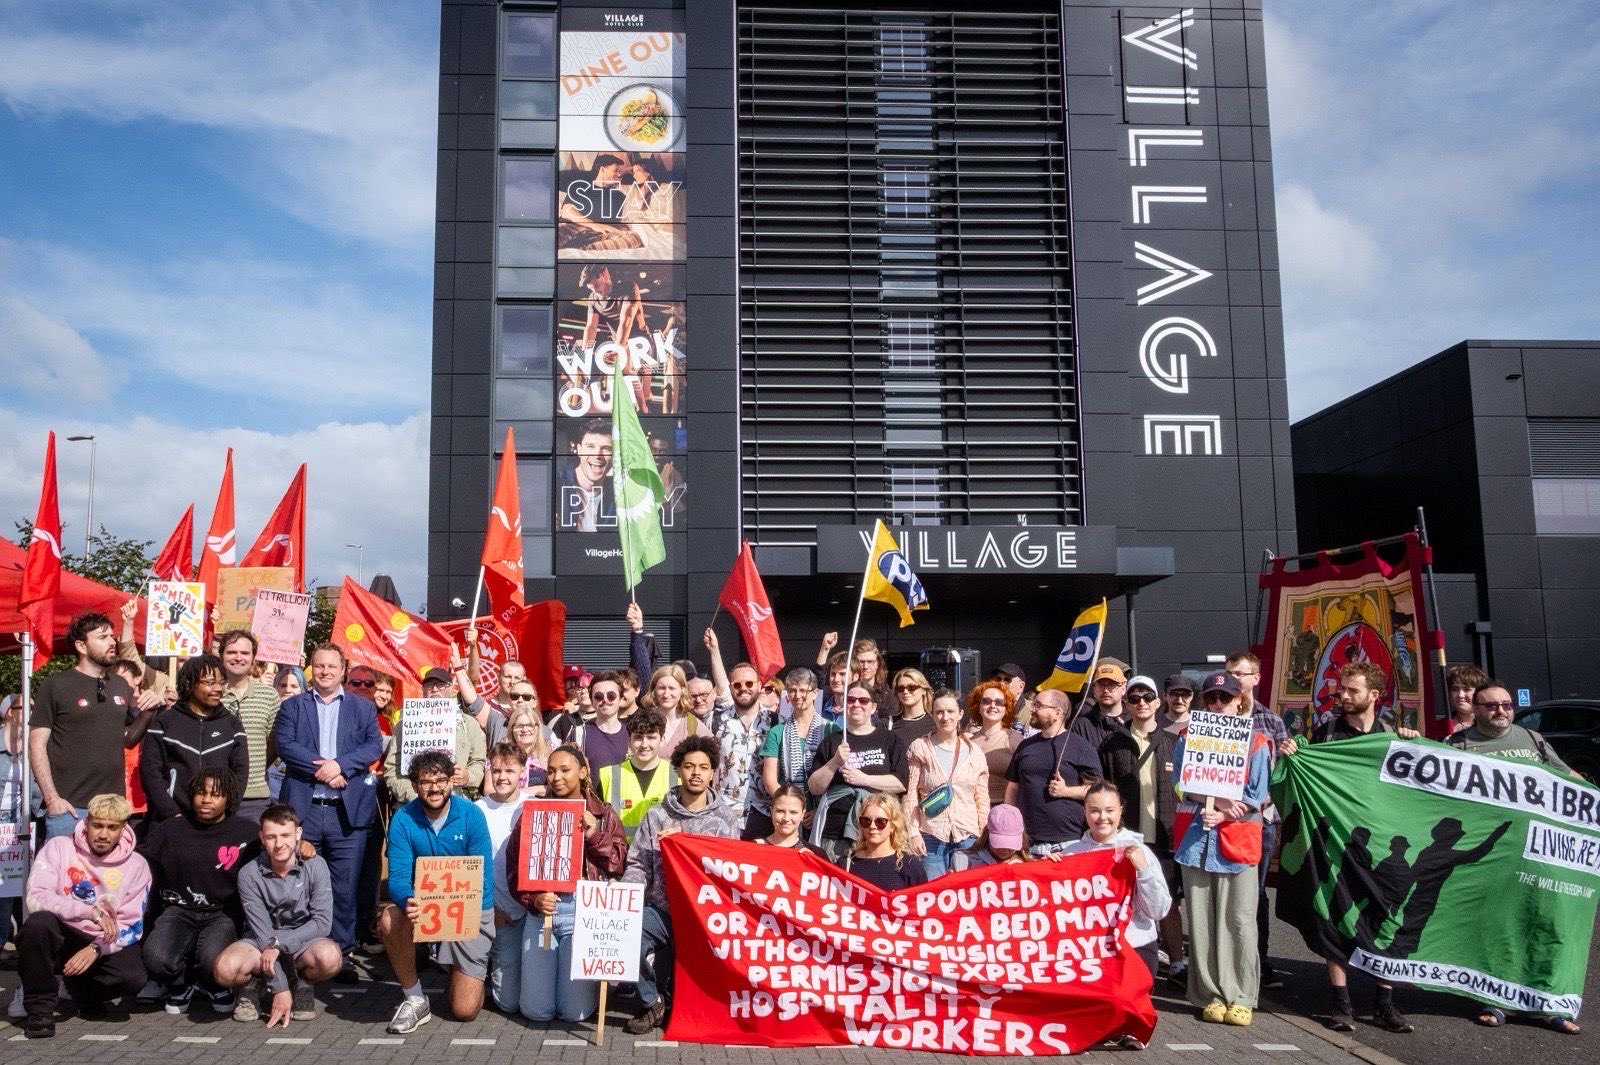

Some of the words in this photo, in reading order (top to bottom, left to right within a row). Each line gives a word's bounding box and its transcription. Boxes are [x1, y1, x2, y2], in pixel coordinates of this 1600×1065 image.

[605, 14, 644, 22] VILLAGE
[560, 51, 628, 96] DINE
[567, 180, 683, 219] STAY
[1122, 8, 1222, 455] VILLAGE
[557, 328, 686, 384] WORK
[561, 485, 687, 526] PLY
[236, 596, 257, 611] PA
[272, 591, 310, 606] TRILLION
[153, 602, 198, 654] SERVED
[504, 636, 516, 660] WORL
[405, 700, 450, 709] EDINBURGH
[404, 720, 443, 728] GLASGOW
[1188, 723, 1222, 738] STEALS
[1223, 728, 1250, 742] FROM
[1191, 711, 1252, 730] BLACKSTONE
[403, 739, 449, 748] ABERDEEN
[1187, 738, 1248, 755] WORKERS
[861, 759, 884, 767] VOICE
[1187, 750, 1204, 763] TO
[1209, 753, 1245, 767] FUND
[1182, 763, 1243, 785] GENOCIDE
[1386, 751, 1518, 803] GOVAN
[1524, 776, 1545, 808] &
[1529, 826, 1576, 863] LIVING
[1577, 839, 1600, 869] RE
[423, 860, 461, 870] VILLAGE
[582, 885, 640, 912] UNITE
[701, 856, 758, 885] NOT
[765, 870, 790, 892] A
[800, 871, 873, 904] PINT
[881, 894, 909, 917] IS
[1051, 874, 1115, 904] NOR
[583, 917, 630, 931] VILLAGE
[697, 884, 722, 904] A
[957, 917, 984, 942] A
[990, 911, 1050, 941] BED
[1055, 896, 1131, 933] MAD
[593, 932, 620, 941] HOTEL
[707, 911, 749, 936] OR
[756, 914, 781, 937] A
[872, 937, 912, 957] OF
[919, 941, 1013, 962] MUSIC
[1020, 928, 1122, 963] PLAYE
[588, 947, 619, 957] BETTER
[582, 958, 625, 976] WAGES
[748, 963, 958, 995] PERMISSION
[941, 958, 1103, 984] EXPRESS
[1360, 954, 1427, 978] TENANTS
[1431, 966, 1442, 980] &
[729, 990, 1002, 1021] HOSPITALITY
[844, 1018, 1071, 1056] WORKERS
